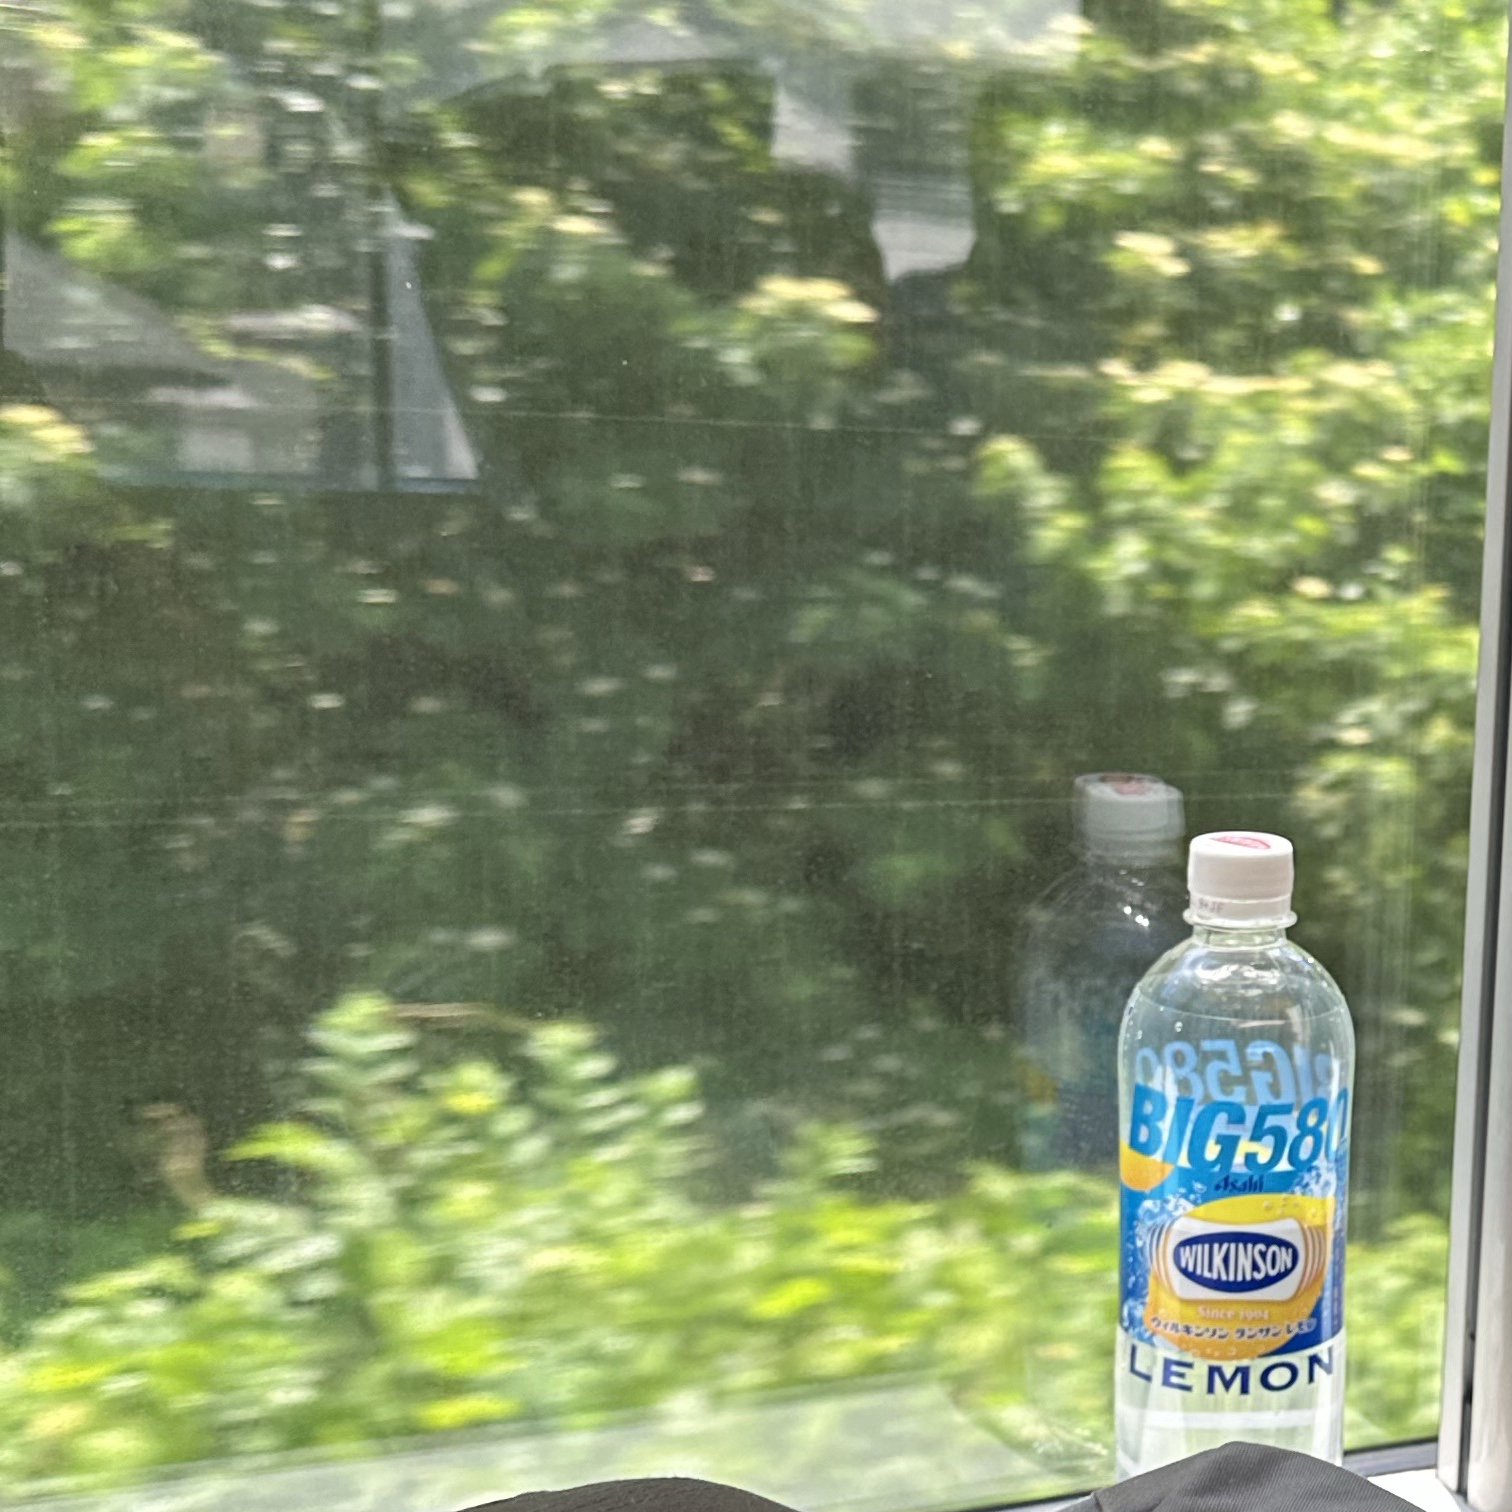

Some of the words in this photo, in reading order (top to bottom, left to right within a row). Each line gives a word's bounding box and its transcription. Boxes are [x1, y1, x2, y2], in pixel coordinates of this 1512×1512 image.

[1129, 1083, 1347, 1172] BIG580
[1215, 1175, 1264, 1192] Asahi
[1180, 1242, 1293, 1282] WILKINSON
[1199, 1305, 1235, 1320] Since
[1129, 1344, 1333, 1396] LEMON
